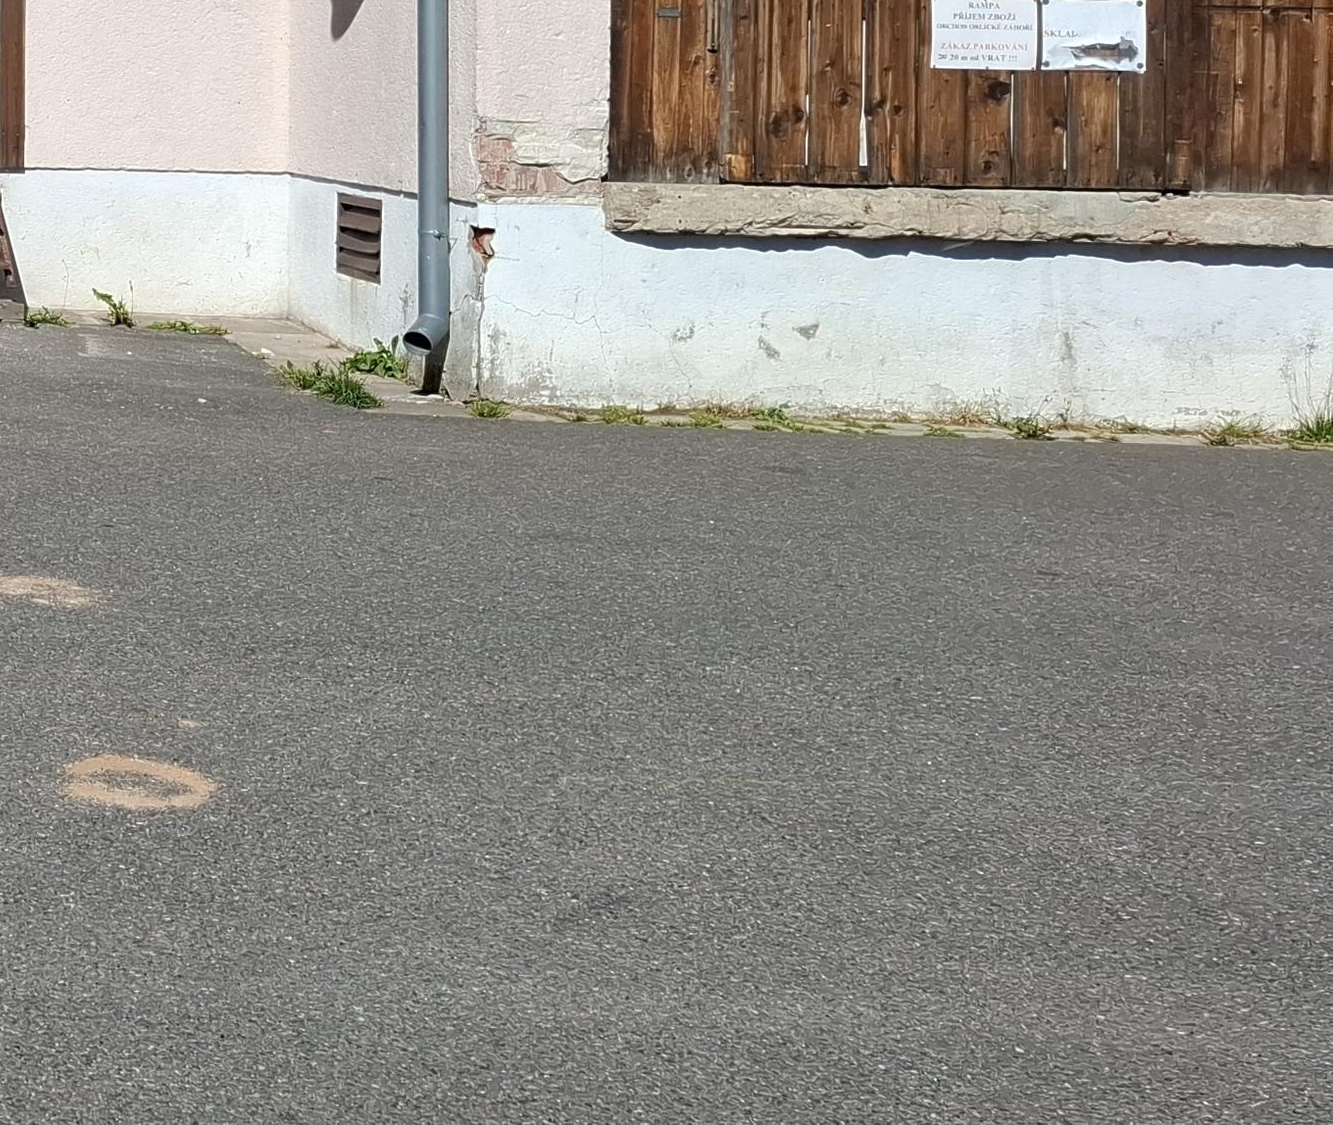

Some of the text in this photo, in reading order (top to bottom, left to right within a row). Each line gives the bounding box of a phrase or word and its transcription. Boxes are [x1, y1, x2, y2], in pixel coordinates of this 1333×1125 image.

[968, 1, 1001, 10] RAMPA
[953, 11, 1016, 21] PŘÍJEM ZBOŽÍ
[940, 42, 1028, 52] ZÁKAZ PARKOVÁNÍ
[981, 54, 1007, 63] VRAT
